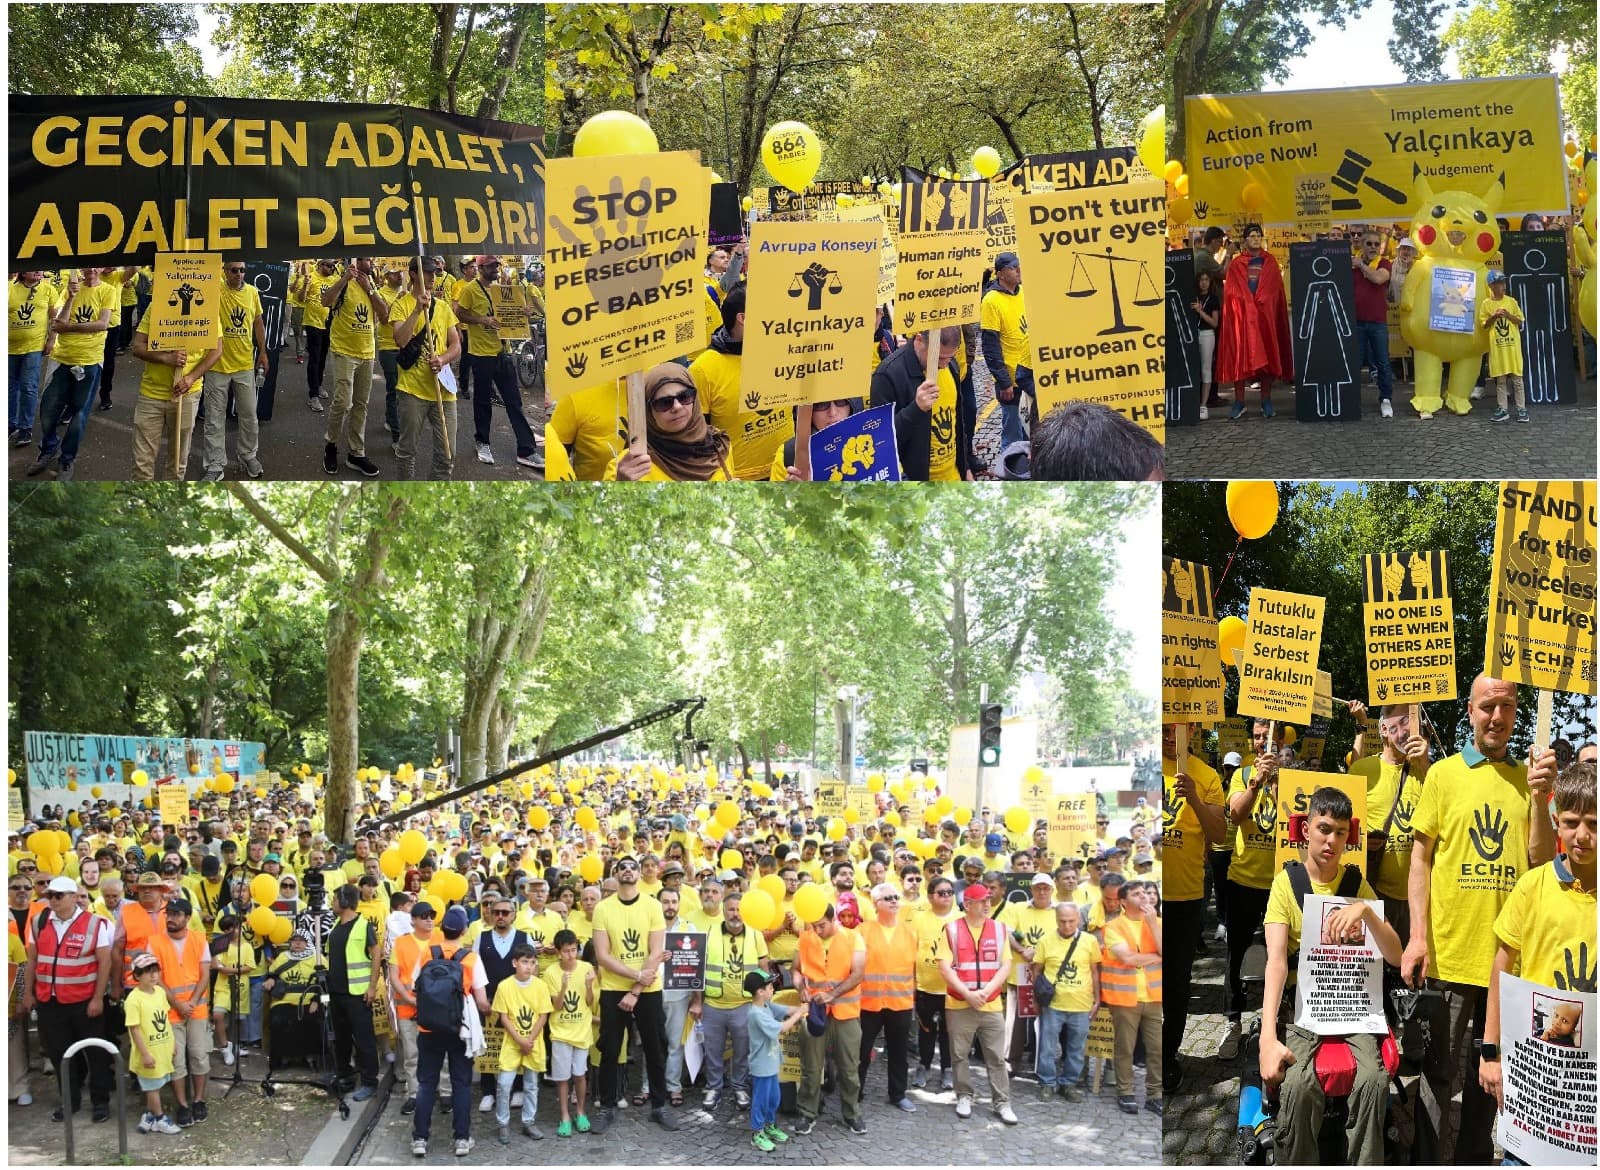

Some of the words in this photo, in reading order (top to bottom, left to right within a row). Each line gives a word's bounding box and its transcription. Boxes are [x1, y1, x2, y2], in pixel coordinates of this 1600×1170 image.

[1391, 103, 1481, 124] Implement
[1485, 102, 1514, 115] the
[1205, 125, 1263, 144] Action
[1268, 119, 1313, 136] from
[1384, 126, 1535, 157] Yalçınkaya
[32, 101, 307, 167] GECİKEN
[326, 121, 524, 184] ADALET,
[772, 135, 807, 155] 864
[1202, 152, 1265, 171] Europe
[1270, 142, 1318, 162] Now!
[1422, 163, 1495, 178] Judgement
[833, 181, 851, 193] FREE
[1300, 182, 1325, 191] STOP
[573, 187, 677, 225] STOP
[1030, 200, 1104, 225] Don't
[1110, 196, 1165, 216] turn
[16, 198, 279, 258] ADALET
[298, 182, 538, 247] DEĞİLDİR!
[547, 243, 592, 264] THE
[600, 225, 699, 255] POLITICAL
[1040, 227, 1101, 252] your
[1109, 220, 1165, 243] eyes
[759, 240, 817, 255] Avrupa
[821, 238, 878, 255] Konseyi
[899, 251, 945, 263] Human
[947, 247, 982, 260] rights
[554, 248, 696, 290] PERSECUTION
[917, 268, 934, 280] for
[937, 266, 963, 278] ALL,
[898, 291, 915, 301] no
[918, 282, 980, 298] exception!
[561, 301, 600, 326] OF
[608, 278, 693, 315] BABYS!
[920, 308, 957, 320] ECHR
[159, 329, 209, 338] maintenant!
[762, 315, 865, 338] Yalçınkaya
[601, 329, 666, 360] ECHR
[787, 343, 834, 355] kararını
[1038, 339, 1137, 362] European
[774, 358, 844, 380] uygulat!
[1038, 369, 1060, 388] of
[1065, 363, 1140, 384] Human
[744, 410, 785, 432] ECHR
[929, 442, 956, 458] ECH
[1502, 488, 1582, 523] STAND
[1519, 530, 1550, 554] for
[1556, 538, 1592, 563] the
[1257, 597, 1316, 620] Tutuklu
[1375, 608, 1395, 620] NO
[1398, 606, 1427, 618] ONE
[1430, 605, 1443, 617] IS
[1495, 592, 1517, 616] in
[1524, 598, 1597, 636] Turkey
[1252, 619, 1317, 642] Hastalar
[1369, 624, 1403, 637] FREE
[1406, 622, 1449, 635] WHEN
[1180, 633, 1217, 650] rights
[1368, 640, 1422, 653] OTHERS
[1424, 638, 1452, 650] ARE
[1173, 654, 1201, 670] ALL,
[1253, 642, 1310, 664] Serbest
[1369, 654, 1453, 671] OPPRESSED!
[1521, 648, 1574, 668] ECHR
[1243, 663, 1313, 687] Bırakılsın
[1393, 681, 1431, 693] ECHR
[1162, 701, 1202, 712] ECHR
[27, 734, 87, 763] JUSTICE
[95, 737, 132, 762] WALL
[1058, 800, 1087, 811] FREE
[1057, 813, 1087, 821] Ekrem
[1247, 833, 1276, 843] ECH
[1461, 863, 1516, 879] ECHR
[1546, 1046, 1557, 1056] VE
[1558, 1049, 1588, 1060] BABASI
[1574, 1103, 1597, 1114] 2020
[1504, 1103, 1526, 1121] VEFAT
[1546, 1126, 1576, 1141] AHMET
[1564, 1122, 1570, 1131] 8
